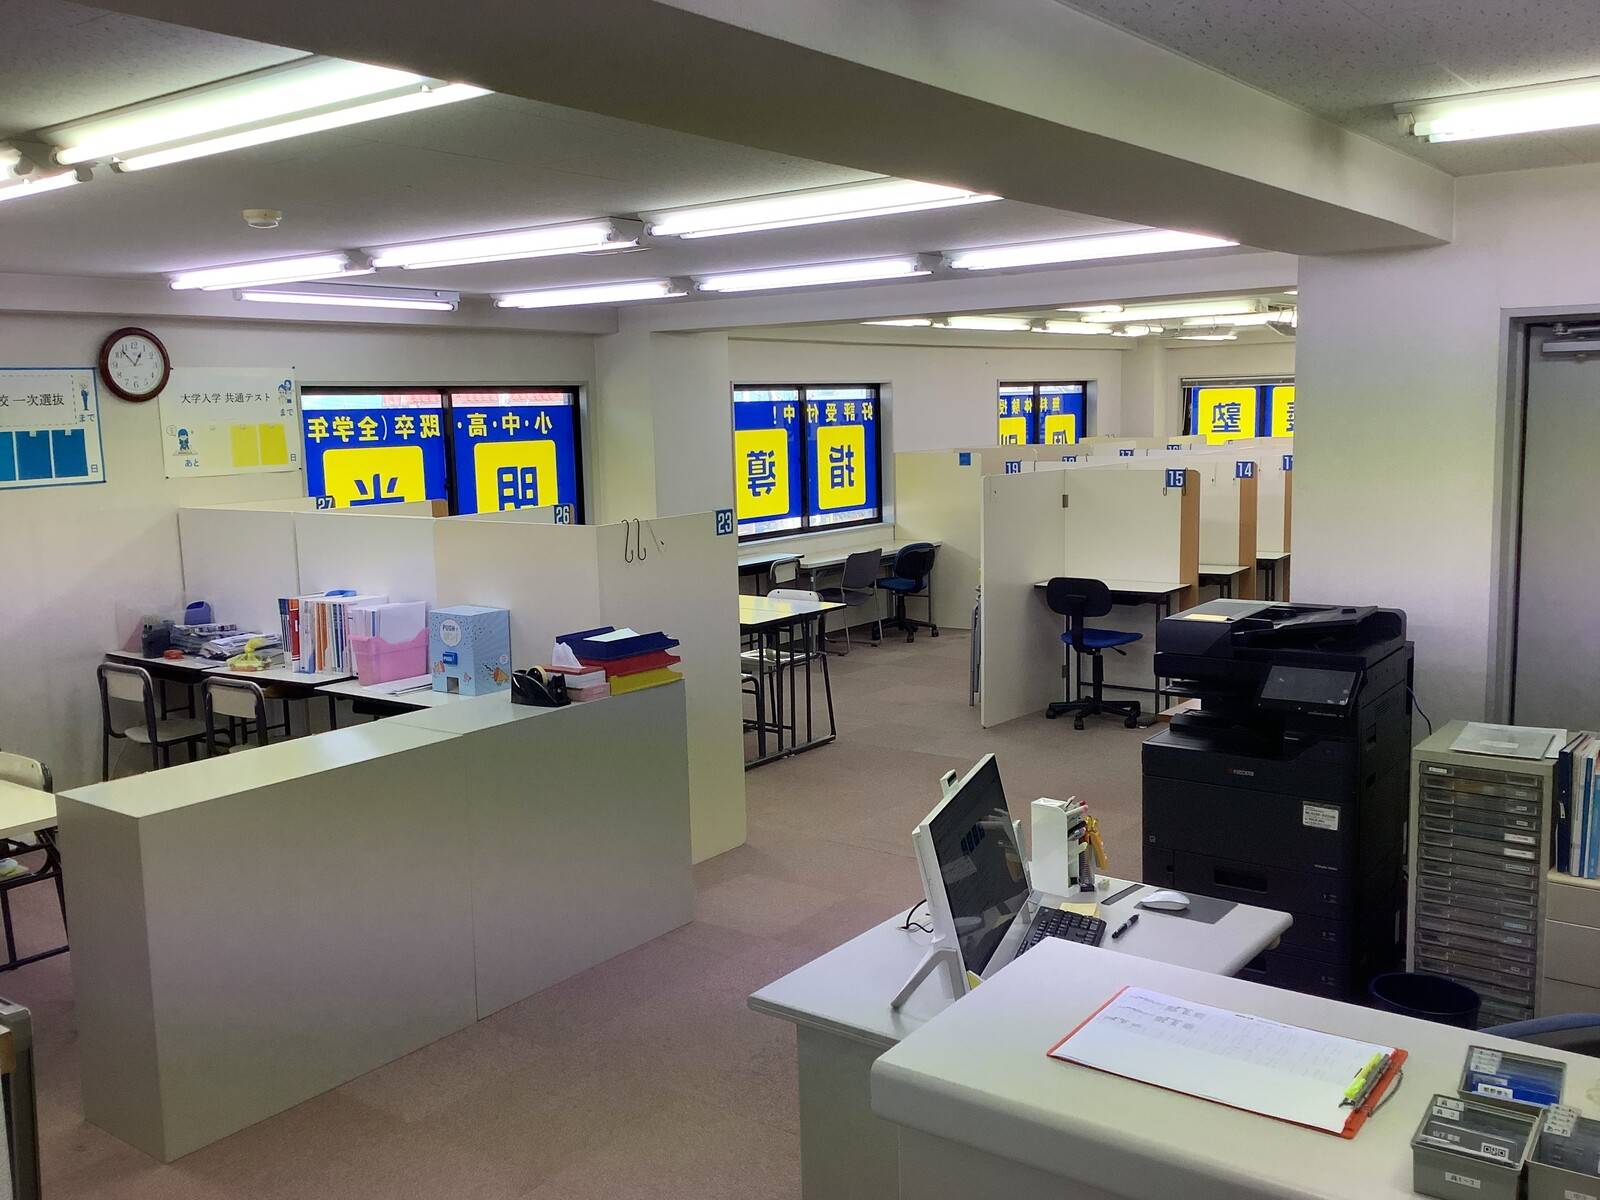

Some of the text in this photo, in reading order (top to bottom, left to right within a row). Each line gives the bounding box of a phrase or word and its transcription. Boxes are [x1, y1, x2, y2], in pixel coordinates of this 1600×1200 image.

[13, 393, 65, 406] 一次選抜
[180, 393, 271, 404] 大学入学 共通テスト
[79, 414, 95, 422] まで
[280, 408, 294, 417] まで
[184, 459, 200, 467] あと
[290, 454, 296, 462] 日
[91, 464, 98, 472] 日
[1007, 462, 1018, 474] 19
[1238, 462, 1252, 477] 14
[1169, 471, 1183, 486] 15
[318, 497, 333, 509] 27
[556, 507, 569, 524] 26
[718, 512, 732, 534] 23
